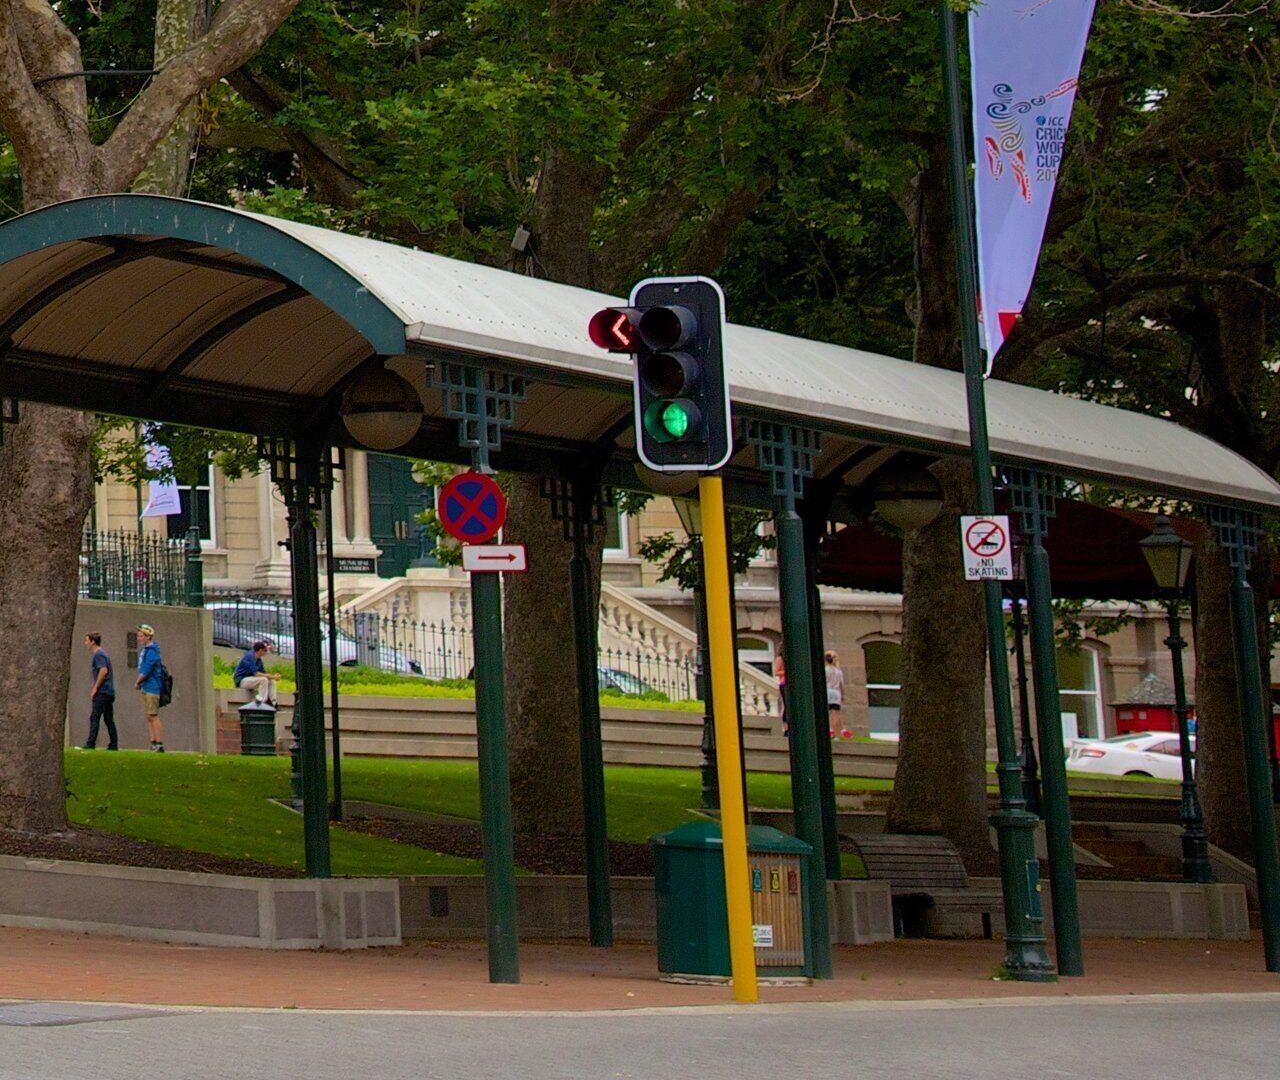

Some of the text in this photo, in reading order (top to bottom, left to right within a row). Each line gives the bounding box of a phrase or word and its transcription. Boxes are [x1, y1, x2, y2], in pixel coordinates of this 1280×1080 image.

[1036, 155, 1060, 168] CUP
[981, 559, 994, 567] NO
[968, 567, 1008, 577] SKATING
